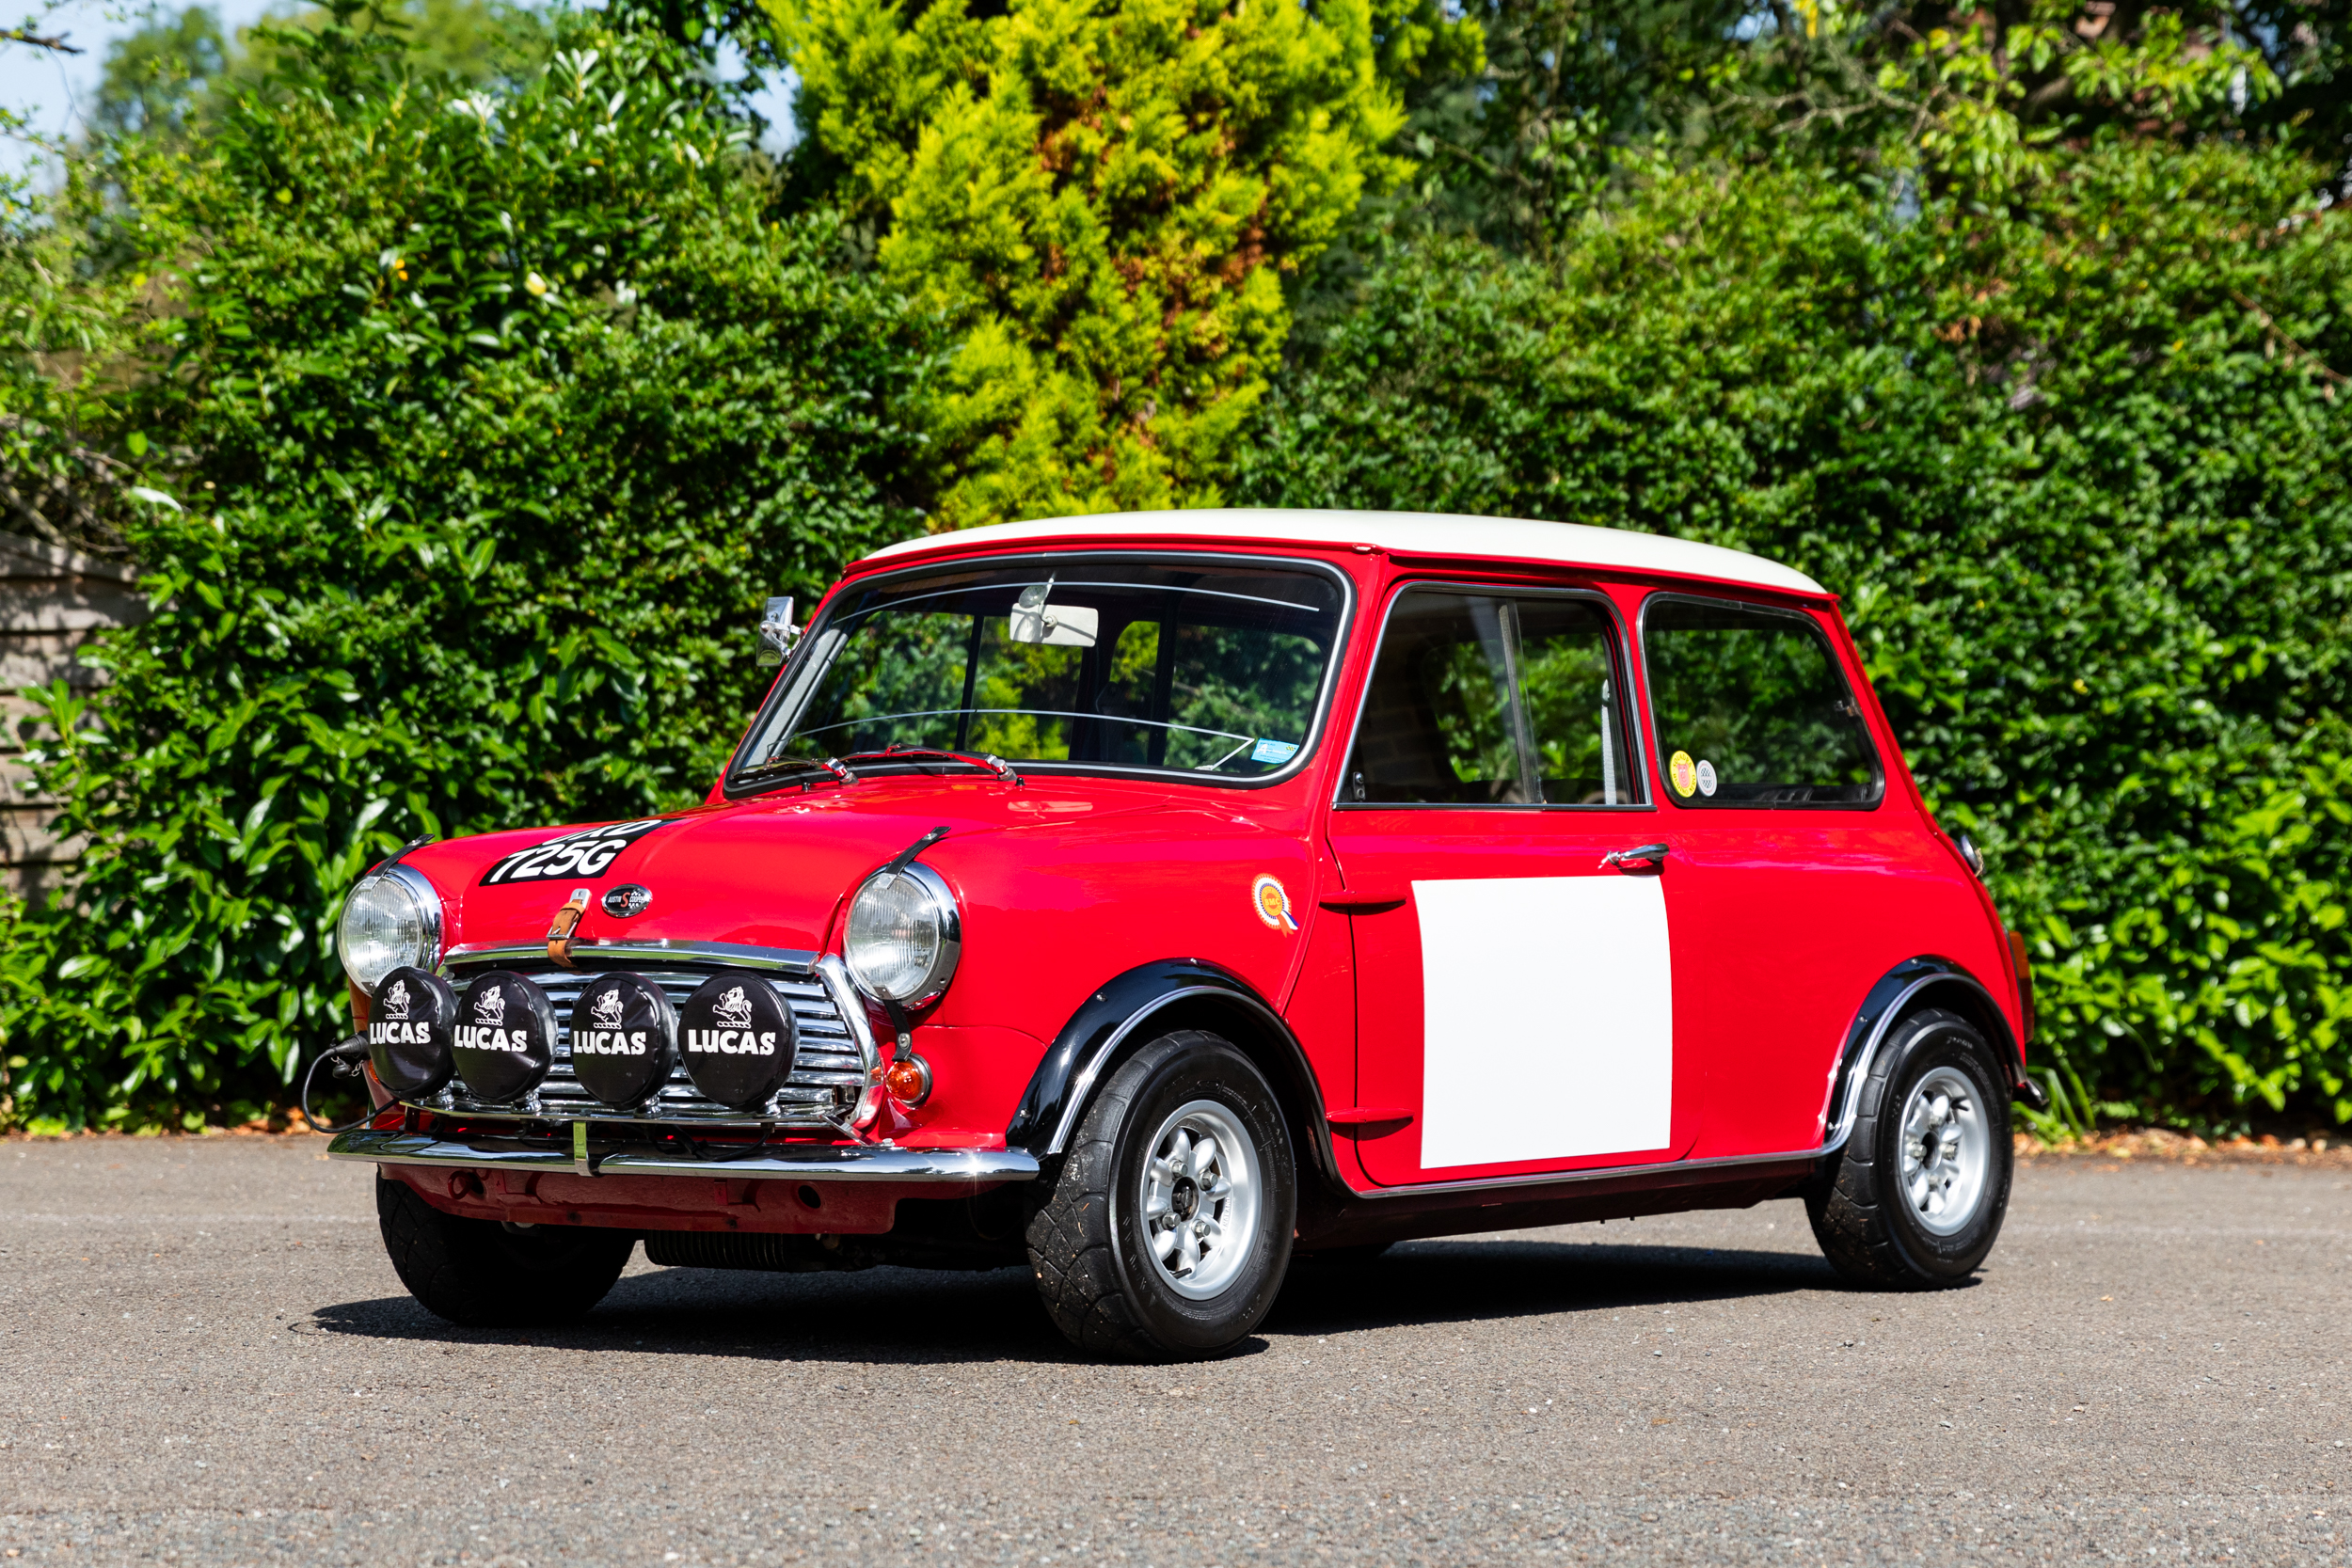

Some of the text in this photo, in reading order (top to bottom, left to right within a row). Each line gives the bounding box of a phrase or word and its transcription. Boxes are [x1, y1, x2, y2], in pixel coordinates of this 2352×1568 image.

[1263, 897, 1280, 906] BMC
[370, 1022, 431, 1045] LUCAS
[453, 1024, 528, 1053] LUCAS
[573, 1030, 646, 1055] LUCAS
[688, 1029, 776, 1056] LUCAS
